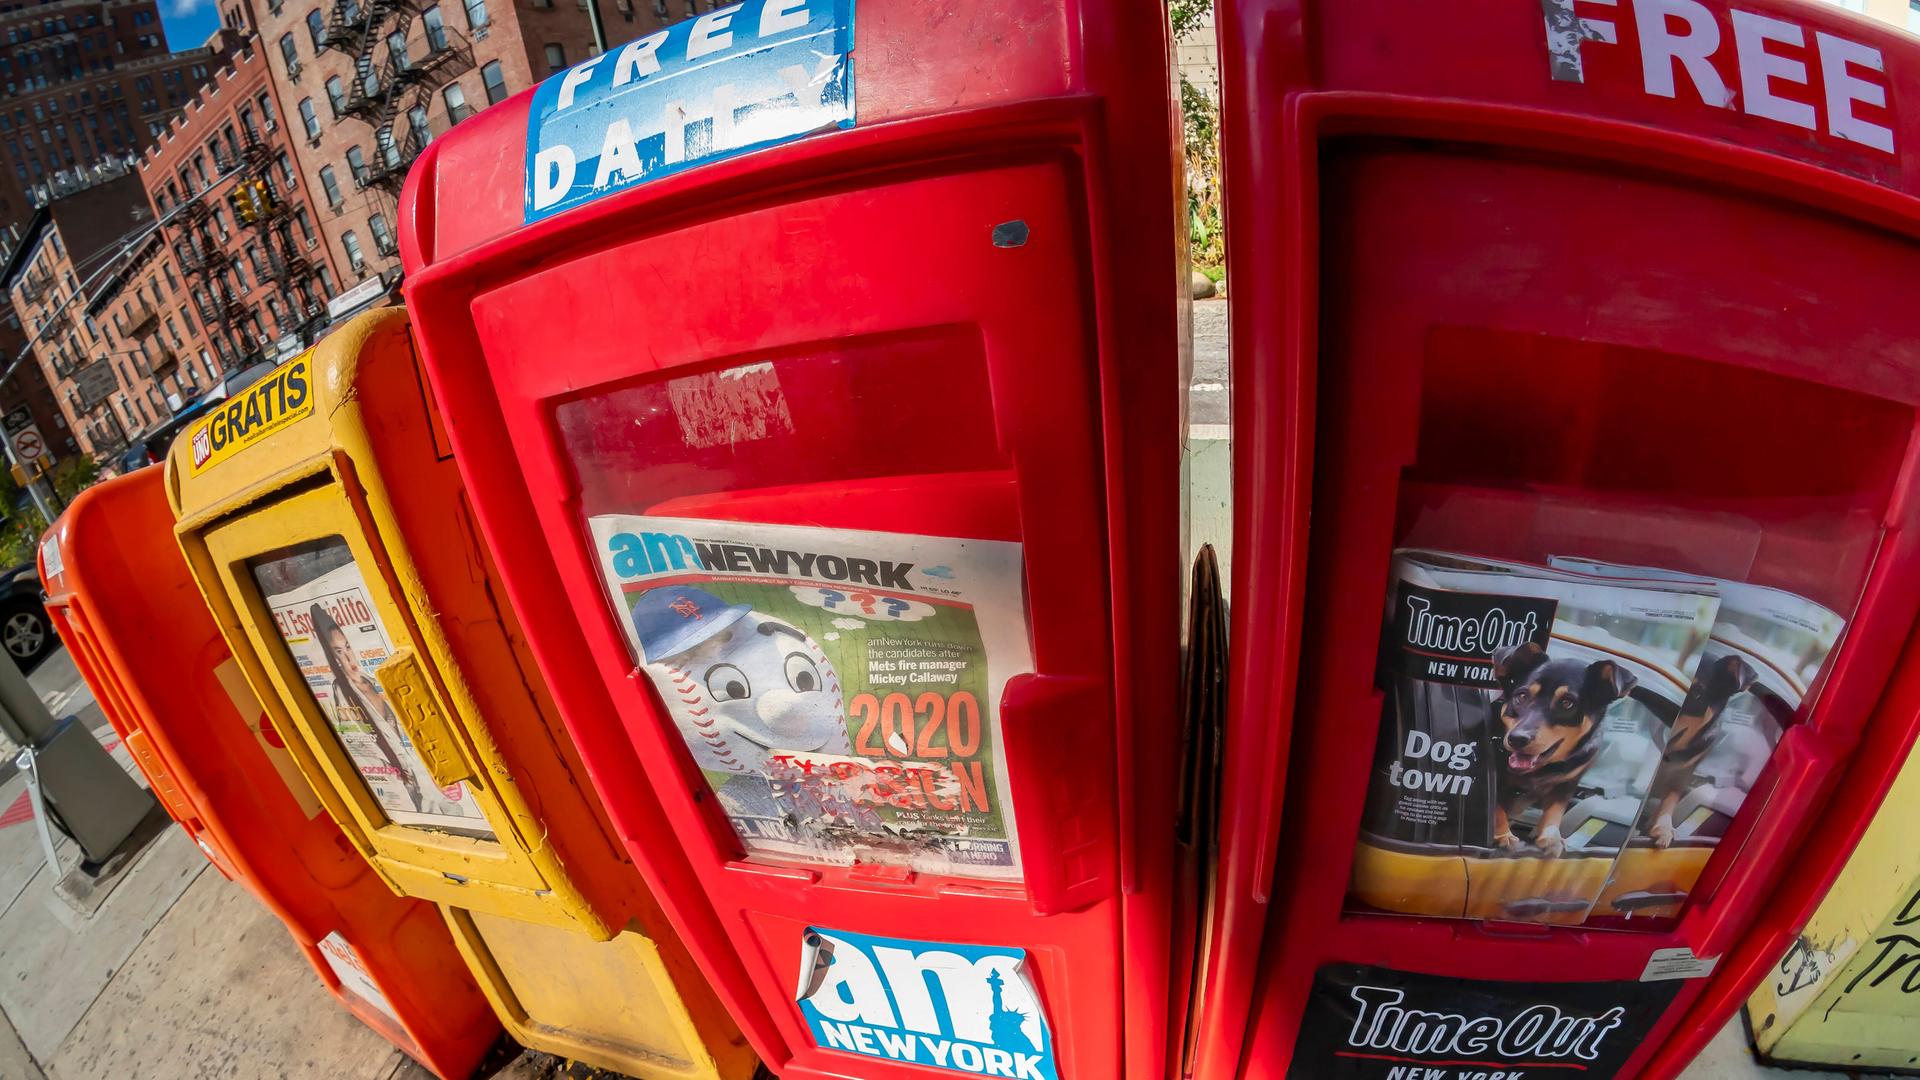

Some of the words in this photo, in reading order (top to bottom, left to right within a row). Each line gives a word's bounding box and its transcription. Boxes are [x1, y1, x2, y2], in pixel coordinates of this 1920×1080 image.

[557, 0, 810, 111] FREE
[1543, 0, 1895, 154] FREE
[210, 363, 308, 451] GRATIS
[273, 611, 293, 638] El
[867, 637, 922, 647] amNewYork
[868, 649, 884, 659] the
[886, 648, 937, 659] candidates
[938, 650, 961, 659] after
[869, 661, 896, 672] Mets
[898, 660, 918, 671] fire
[919, 661, 967, 671] manager
[869, 673, 908, 685] Mickey
[909, 672, 958, 683] Callaway
[1428, 661, 1458, 677] NEW
[850, 691, 981, 758] 2020
[1404, 730, 1477, 770] Dog
[1389, 761, 1473, 795] town
[896, 811, 920, 820] PLUS
[970, 852, 997, 860] HERO
[804, 932, 1043, 1052] am
